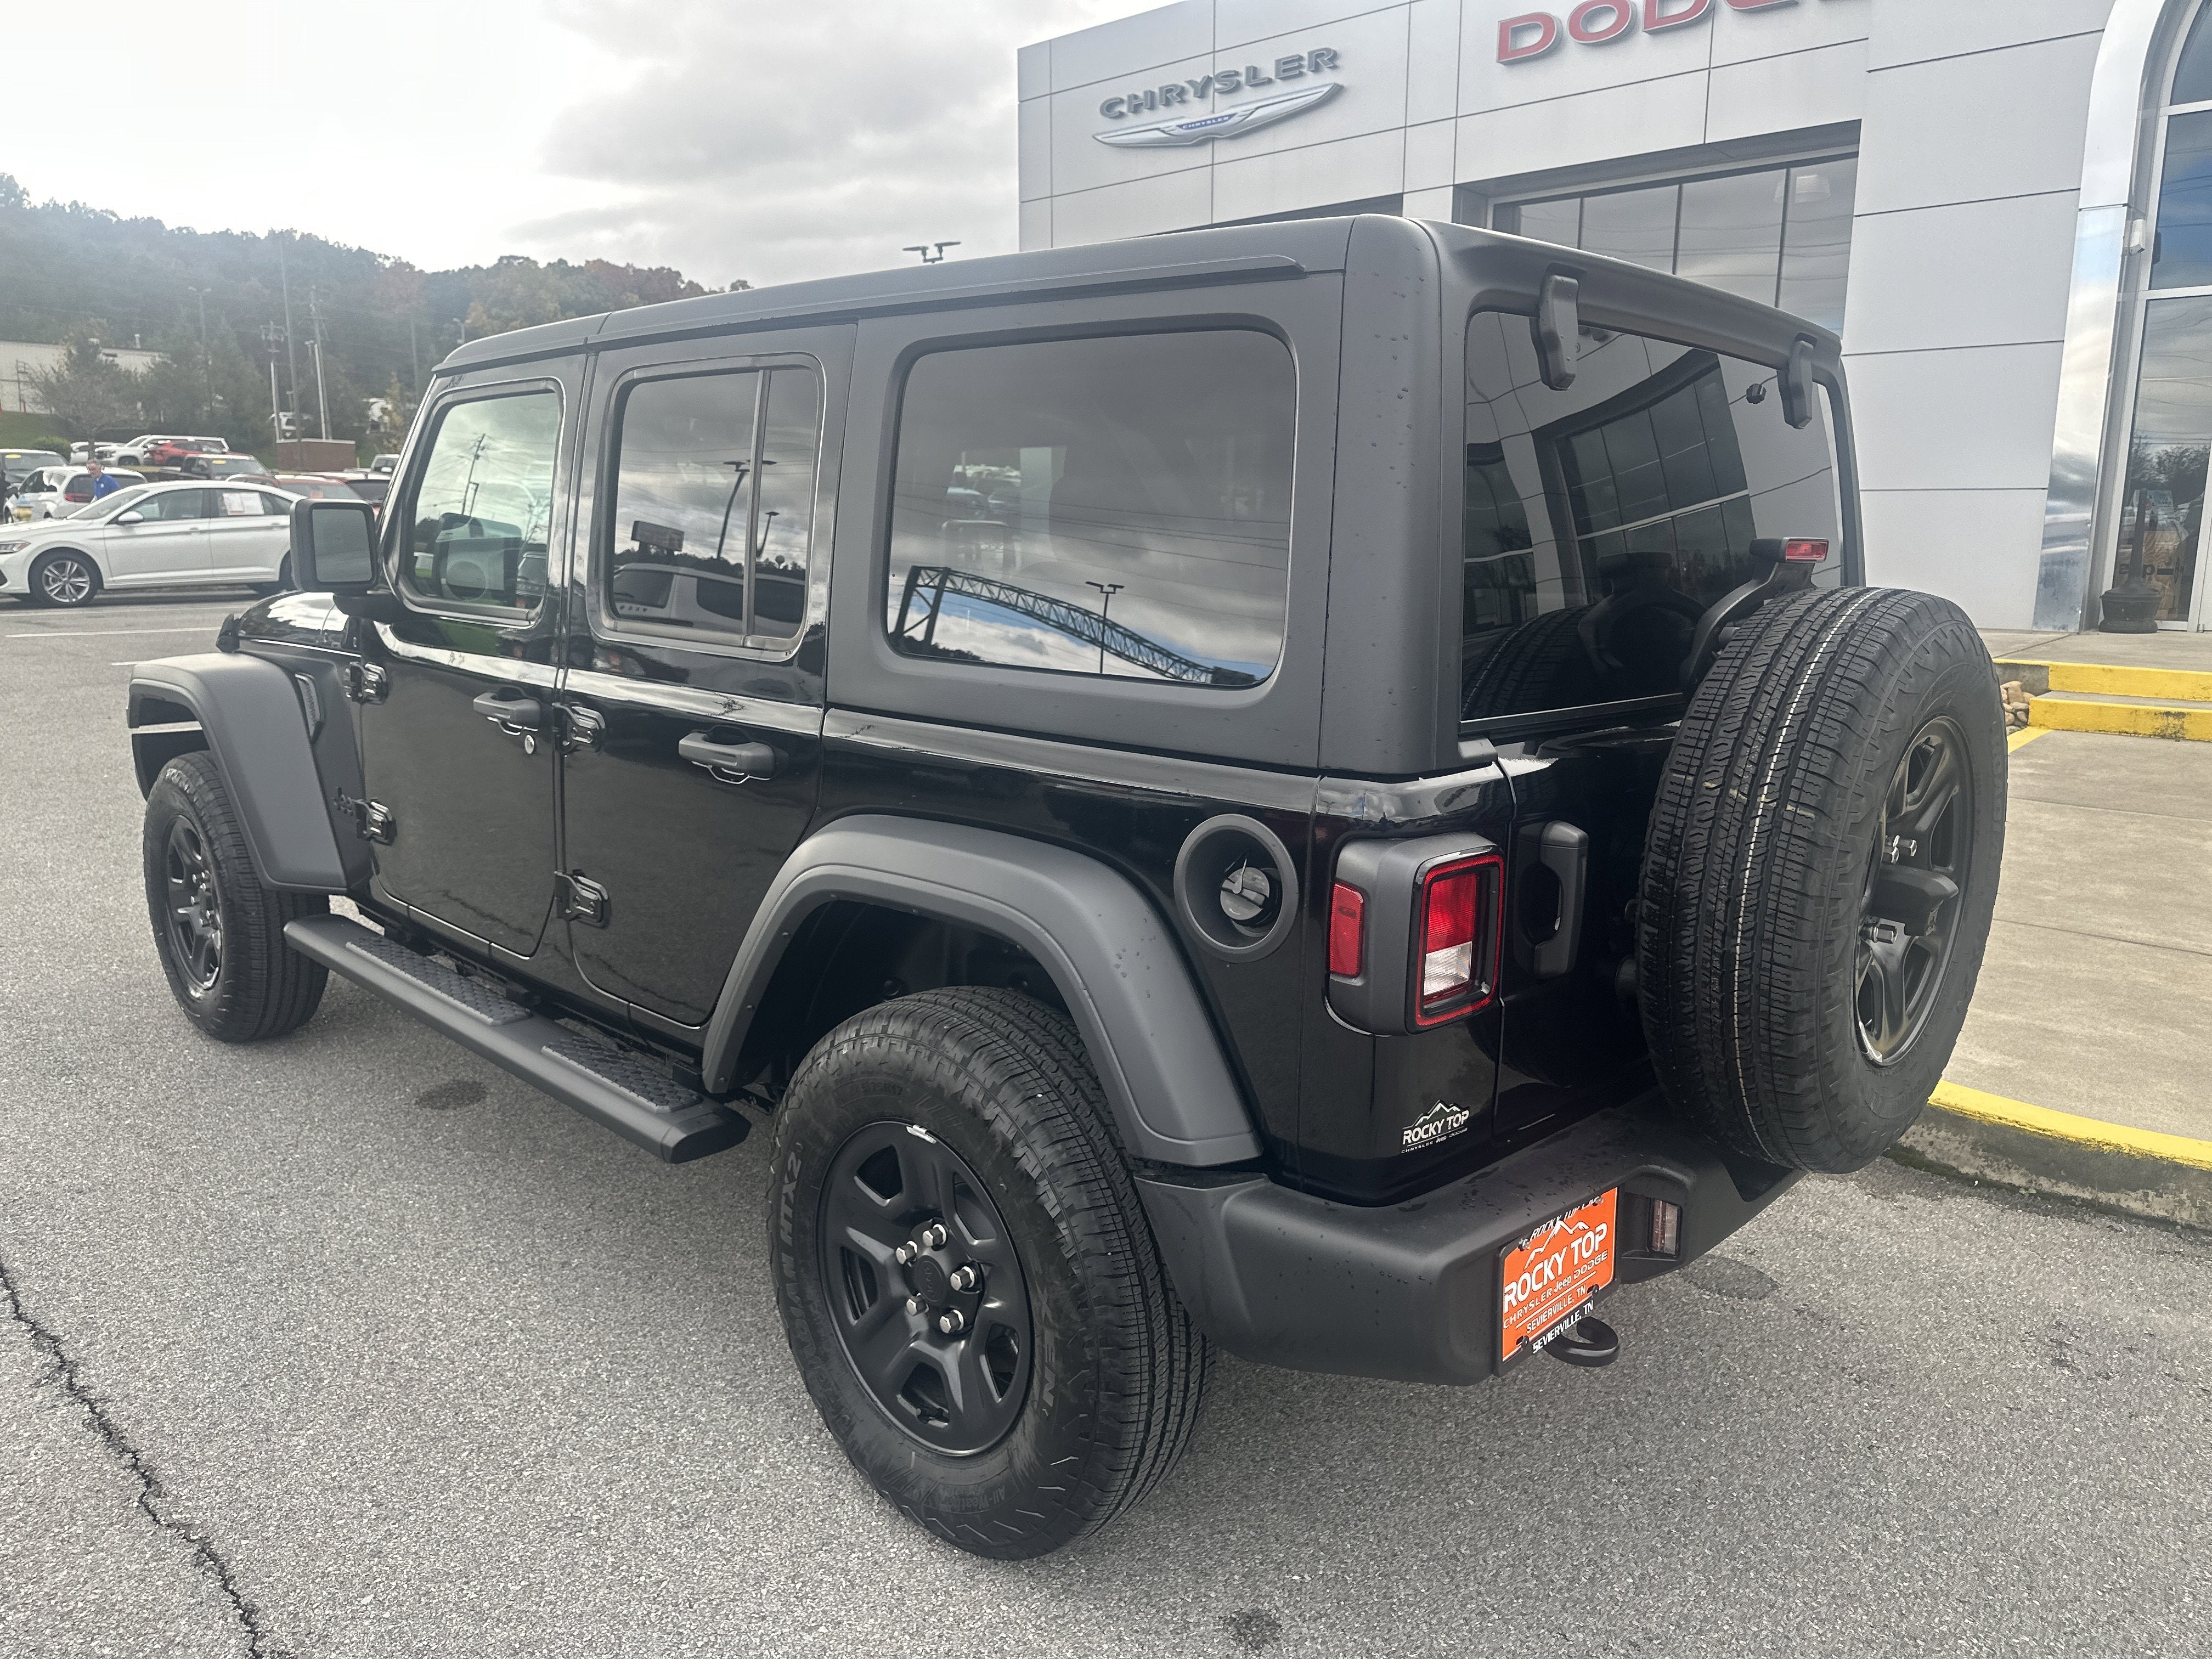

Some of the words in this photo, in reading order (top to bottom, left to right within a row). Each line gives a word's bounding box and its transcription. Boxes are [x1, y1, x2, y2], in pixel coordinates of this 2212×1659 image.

[1497, 0, 1790, 64] DOD
[1099, 47, 1339, 119] CHRYSLER
[1182, 116, 1229, 129] CHRYSLER
[1401, 1141, 1433, 1154] CHRYSLER
[1403, 1119, 1445, 1145] ROCKY
[1447, 1110, 1469, 1130] TOP
[1503, 1288, 1552, 1329] CHRYSLER
[1554, 1275, 1572, 1293] Jeep
[1574, 1250, 1607, 1280] DODGE
[1504, 1245, 1568, 1313] ROCKY
[1571, 1223, 1607, 1266] TOP
[1527, 1293, 1574, 1334] SEVIERVILLE,
[1577, 1284, 1587, 1299] TN
[1532, 1313, 1582, 1353] SEVIERVILLE,
[1583, 1300, 1594, 1316] TN
